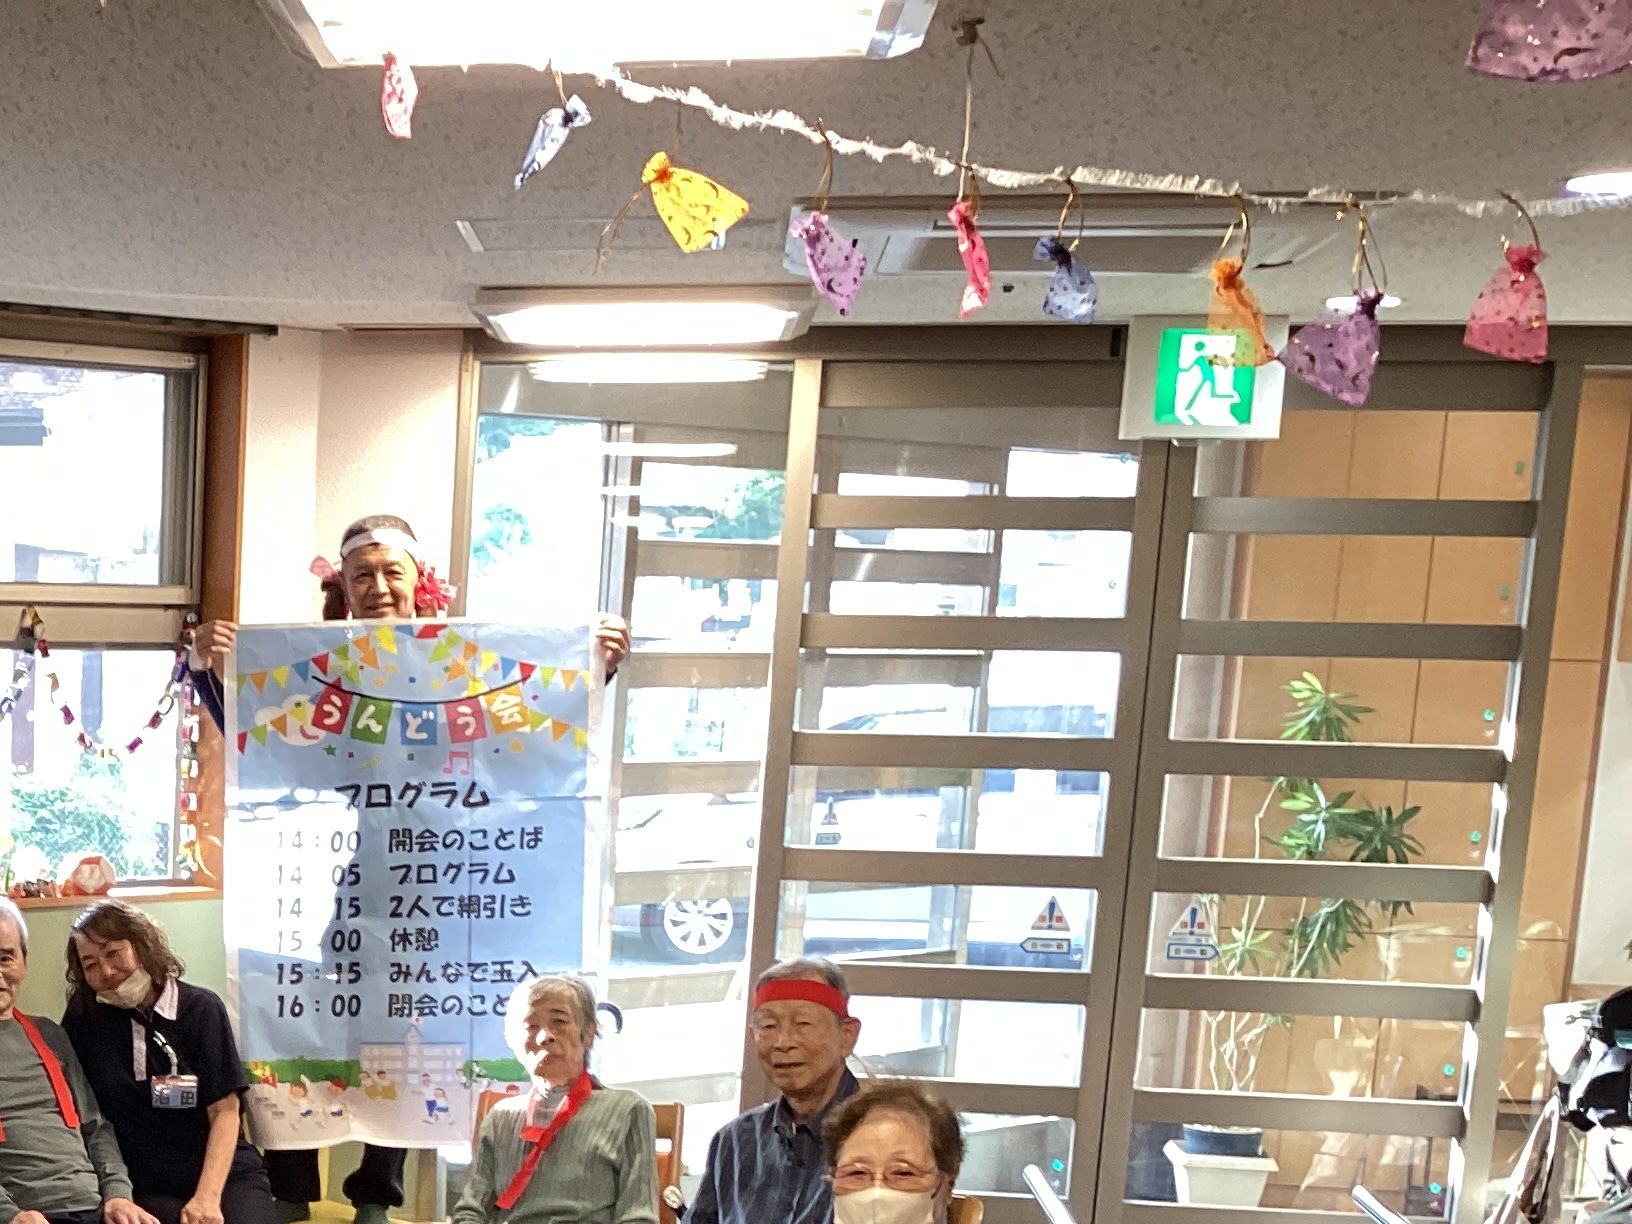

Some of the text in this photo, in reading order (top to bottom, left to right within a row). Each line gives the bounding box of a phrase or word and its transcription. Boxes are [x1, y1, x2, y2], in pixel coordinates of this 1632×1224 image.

[322, 691, 522, 740] うんどう会
[334, 780, 491, 810] プログラム
[388, 826, 545, 853] 開会のことば
[388, 861, 517, 886] プログラム
[388, 893, 533, 920] 2人で綱引き
[388, 926, 440, 953] 休憩
[388, 959, 540, 985] みんなで玉入
[387, 993, 510, 1019] 閉会のこと
